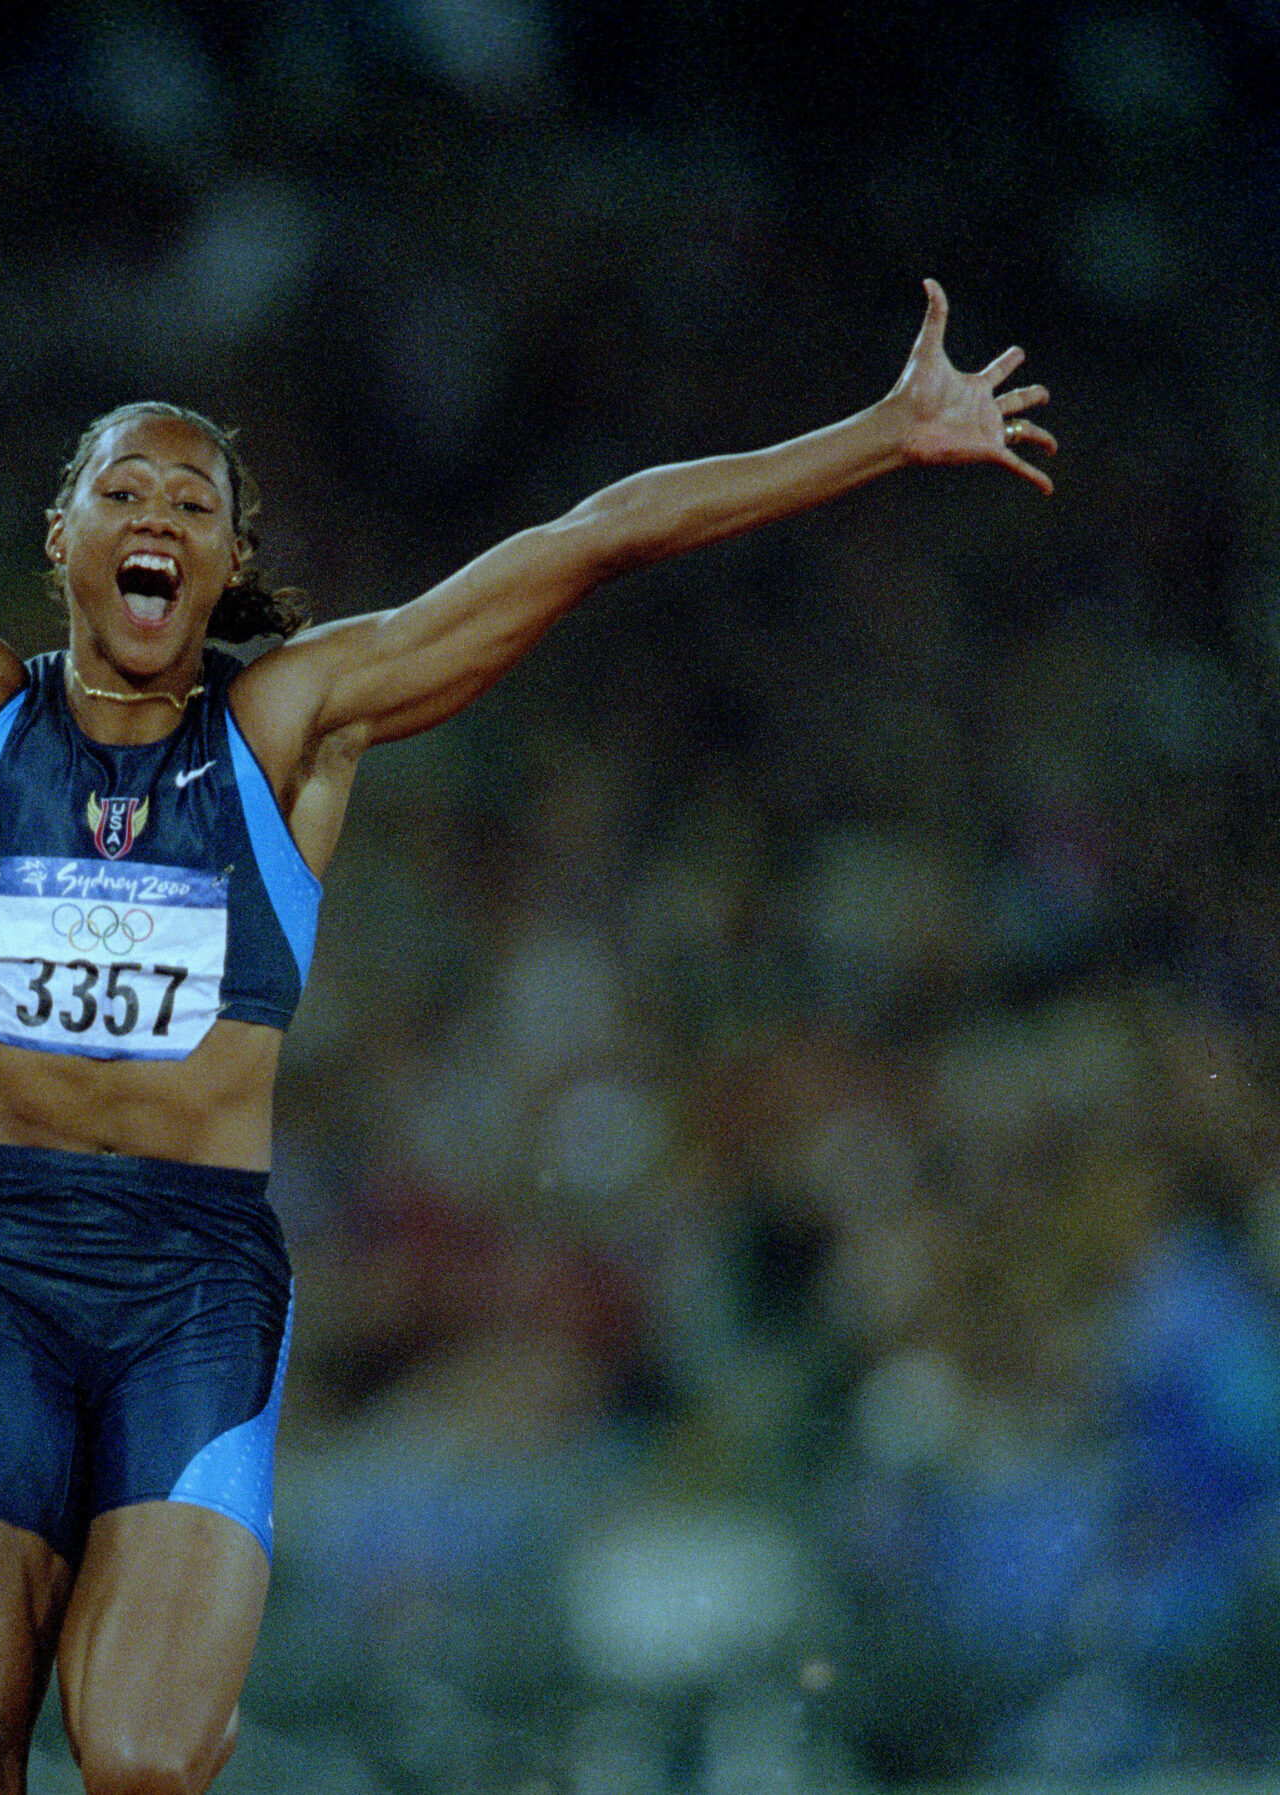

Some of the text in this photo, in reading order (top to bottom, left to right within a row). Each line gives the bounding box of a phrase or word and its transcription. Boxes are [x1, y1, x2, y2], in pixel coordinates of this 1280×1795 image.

[107, 802, 123, 845] USA
[56, 862, 190, 902] Sydney 2000
[16, 958, 188, 1036] 3357
